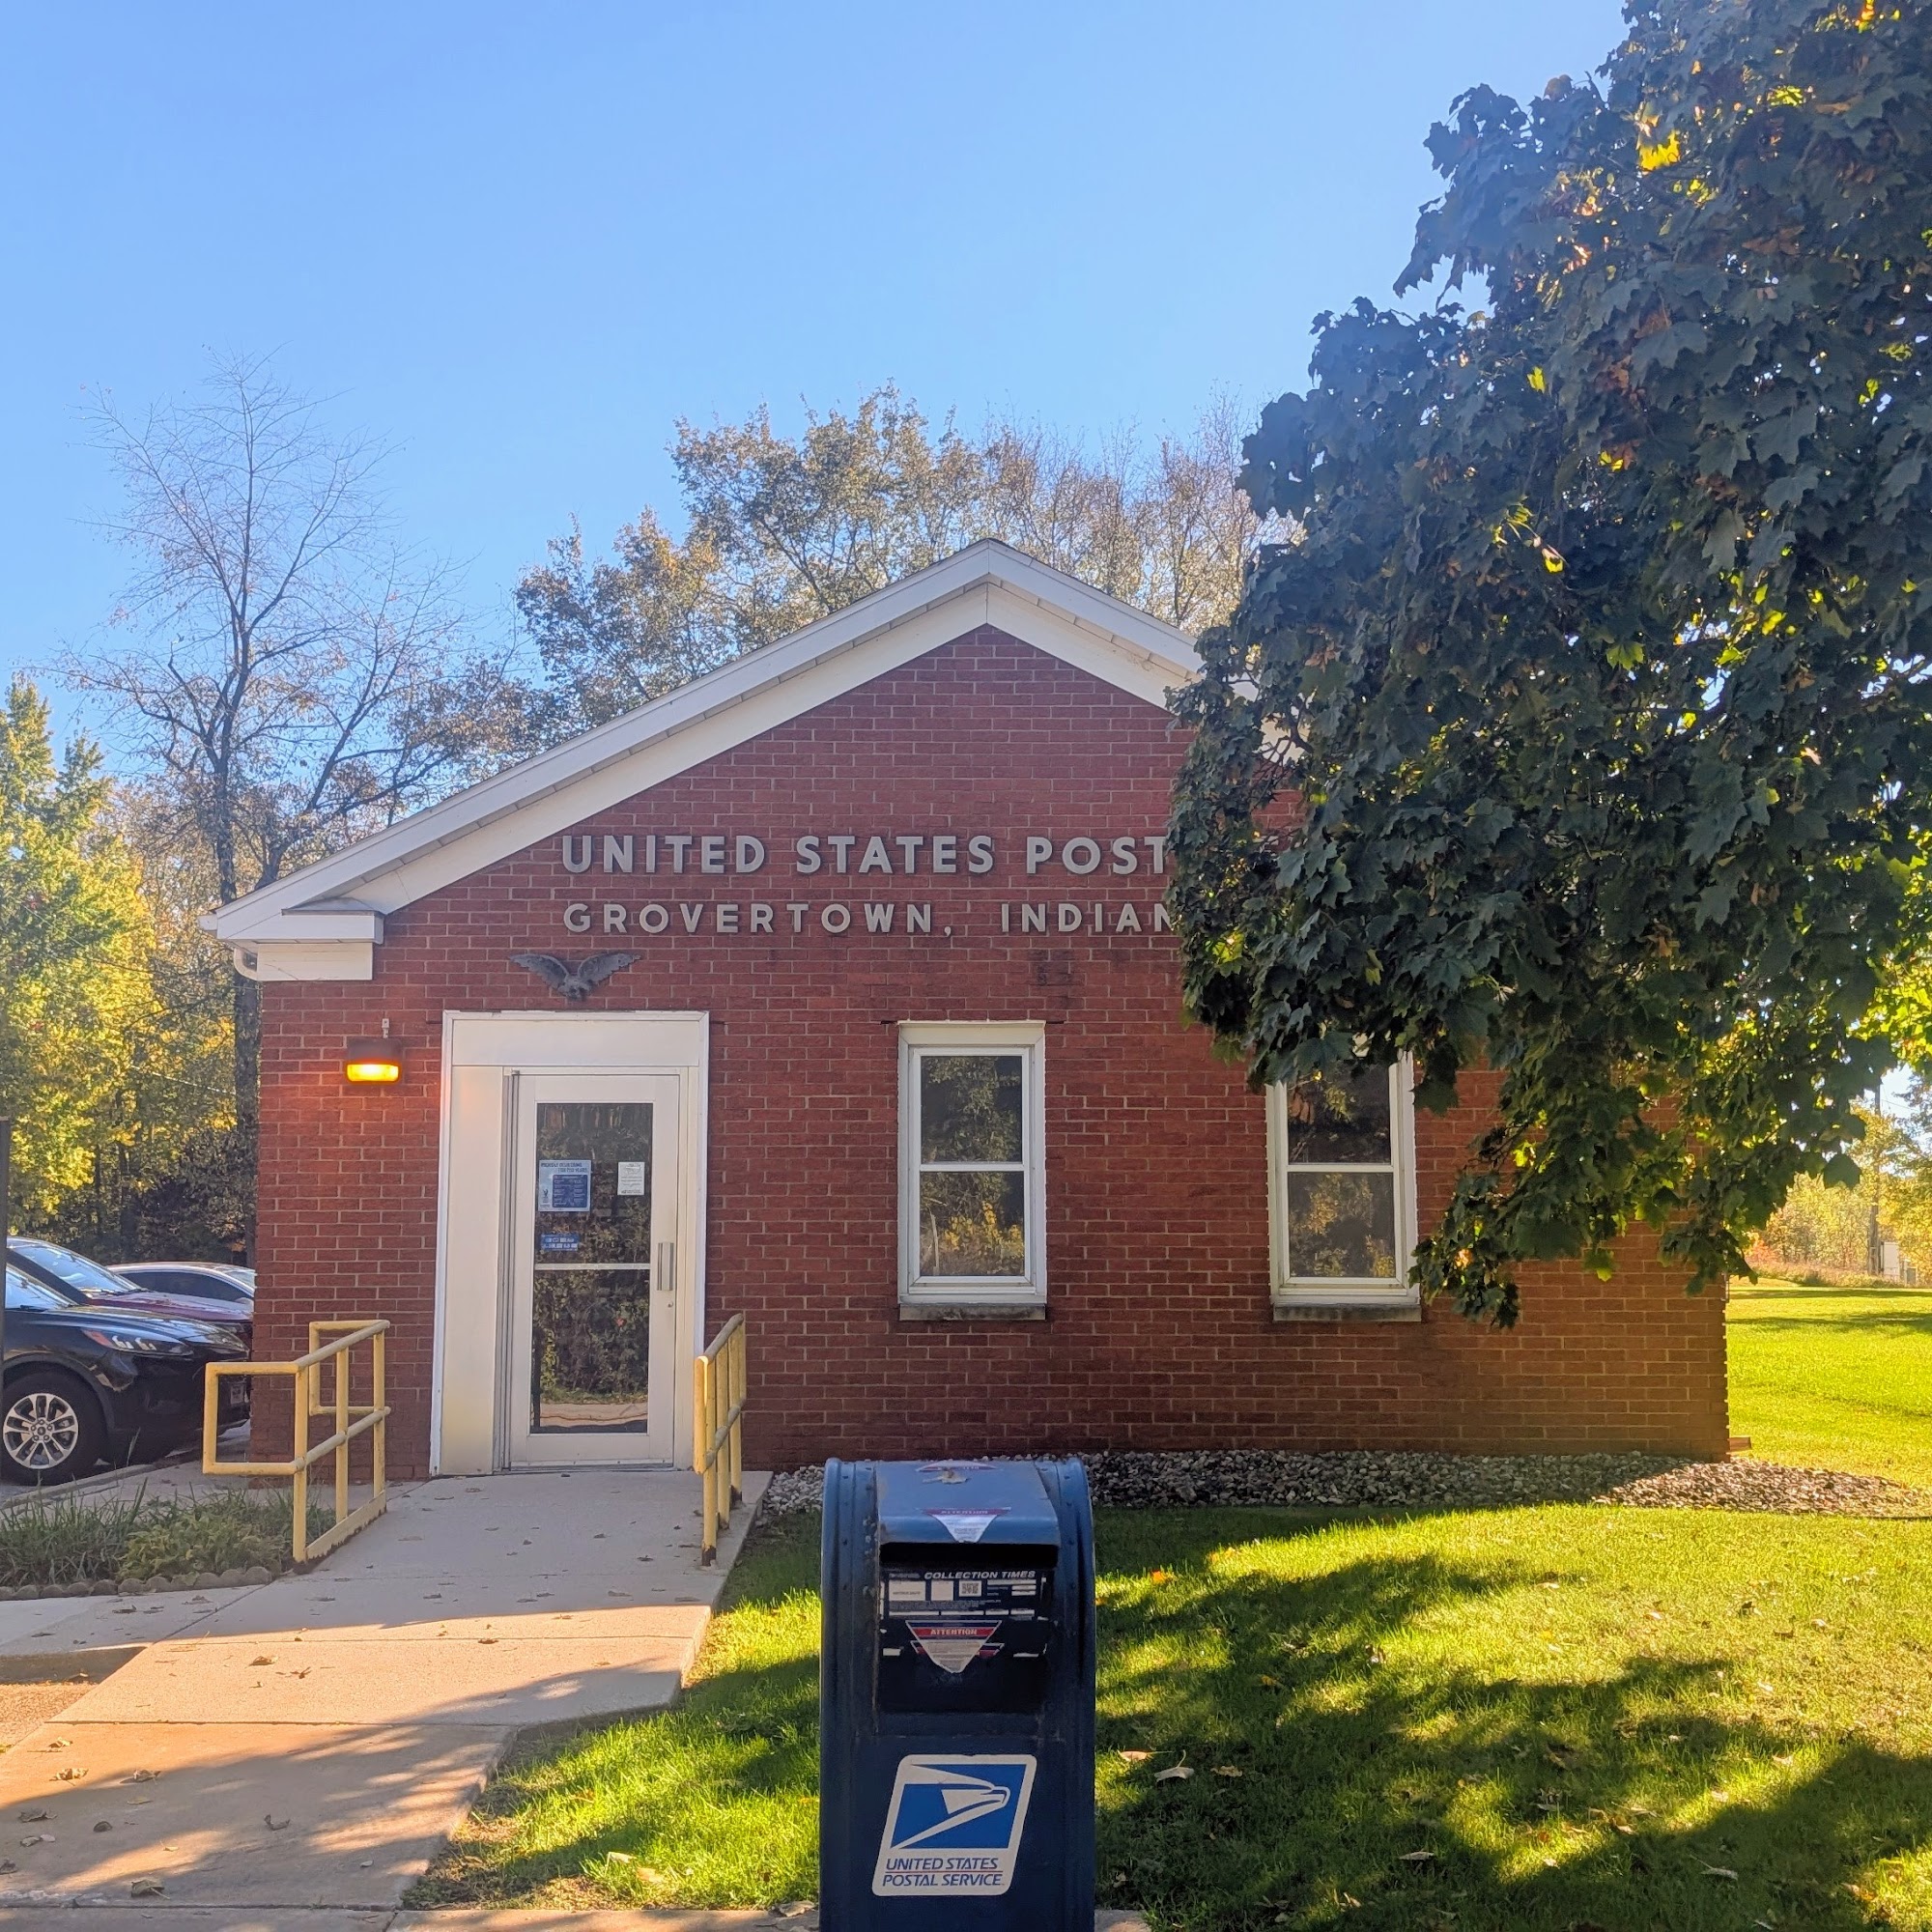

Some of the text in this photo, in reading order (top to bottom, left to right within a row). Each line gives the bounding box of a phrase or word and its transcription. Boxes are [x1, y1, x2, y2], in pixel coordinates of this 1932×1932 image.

[561, 835, 1167, 874] UNITED STATES POST
[562, 903, 1173, 936] GROVERTOWN, INDIAN
[1002, 1570, 1037, 1578] TIMES
[886, 1858, 999, 1870] UNITED STATES
[882, 1874, 1003, 1887] POSTAL SERVICE
